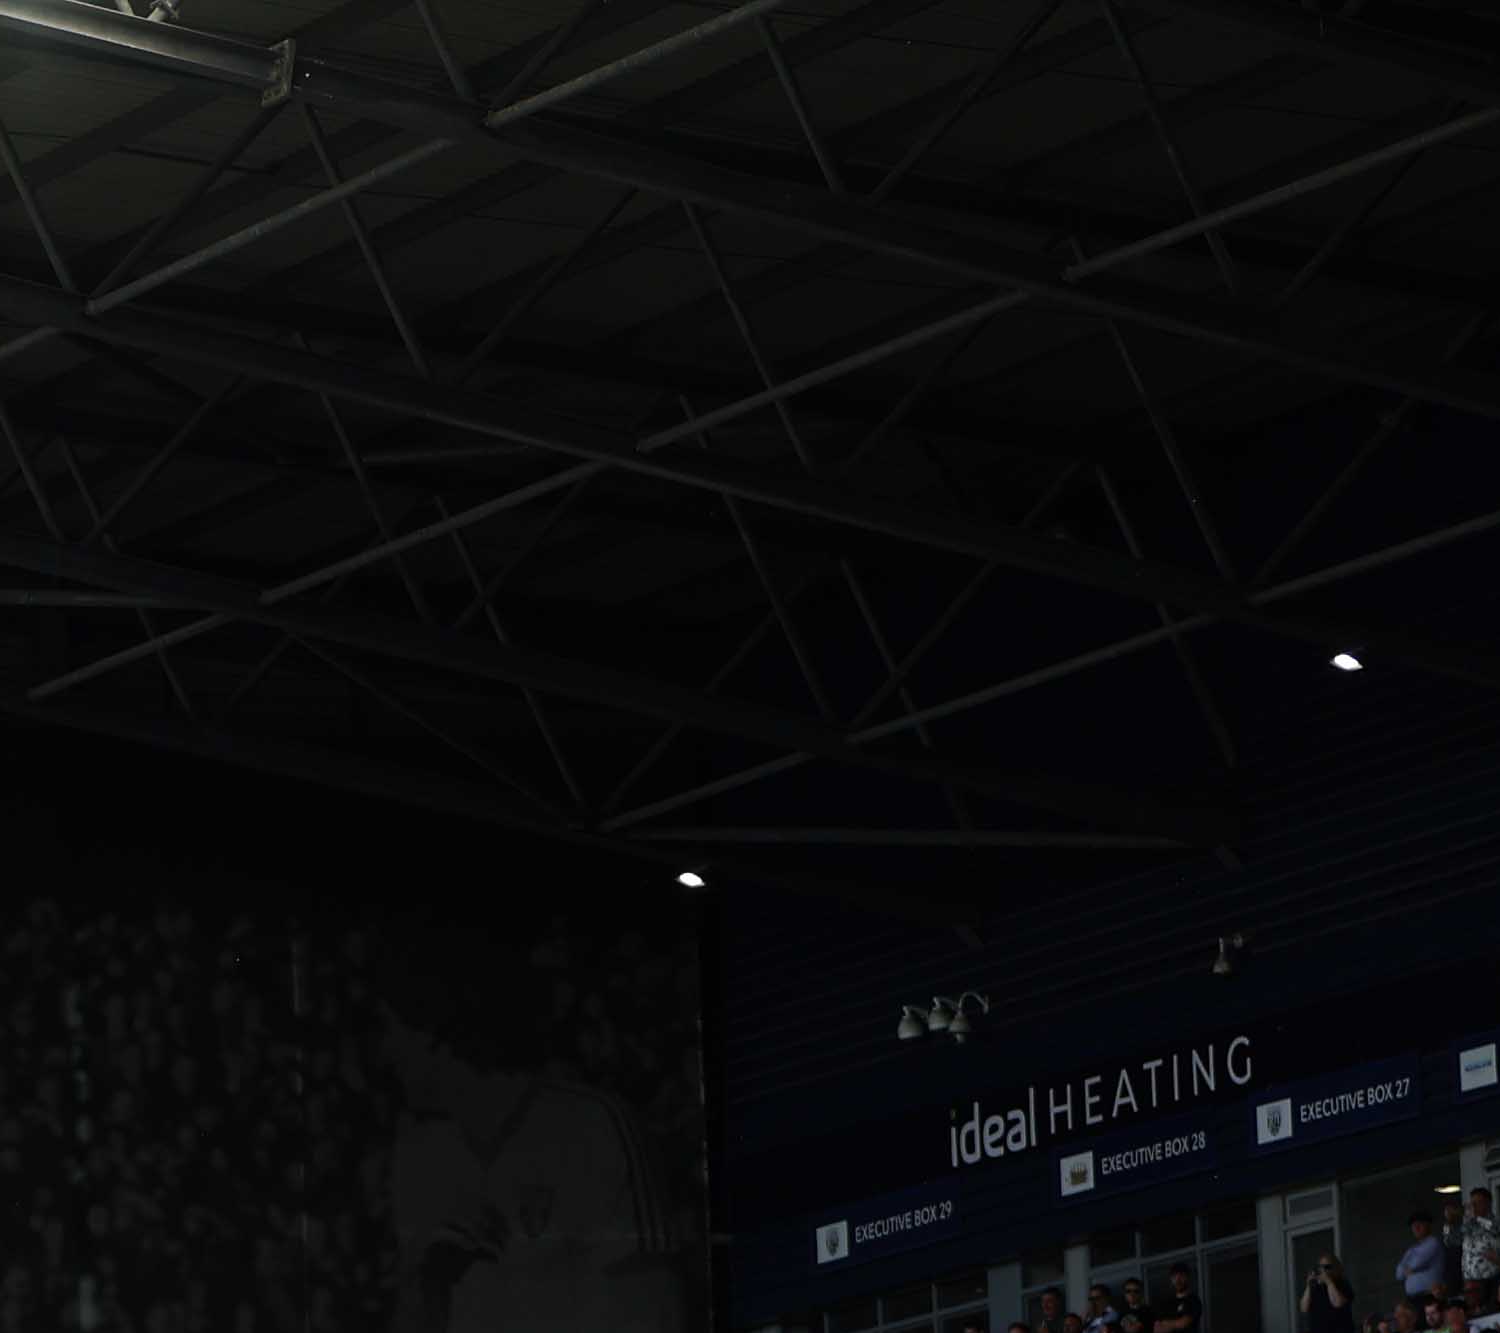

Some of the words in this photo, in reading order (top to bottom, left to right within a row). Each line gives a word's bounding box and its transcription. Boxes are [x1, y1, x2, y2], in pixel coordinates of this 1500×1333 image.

[949, 1087, 1037, 1167] ideal
[1048, 1035, 1253, 1135] HEATING
[1300, 1089, 1365, 1124] EXECUTIVE
[1367, 1081, 1394, 1106] BOX
[1395, 1077, 1411, 1099] 27
[1101, 1143, 1163, 1175] EXECUTIVE
[1165, 1136, 1189, 1158] BOX
[1191, 1131, 1206, 1152] 28
[855, 1211, 912, 1243] EXECUTIVE
[914, 1206, 937, 1227] BOX
[939, 1200, 952, 1219] 29
